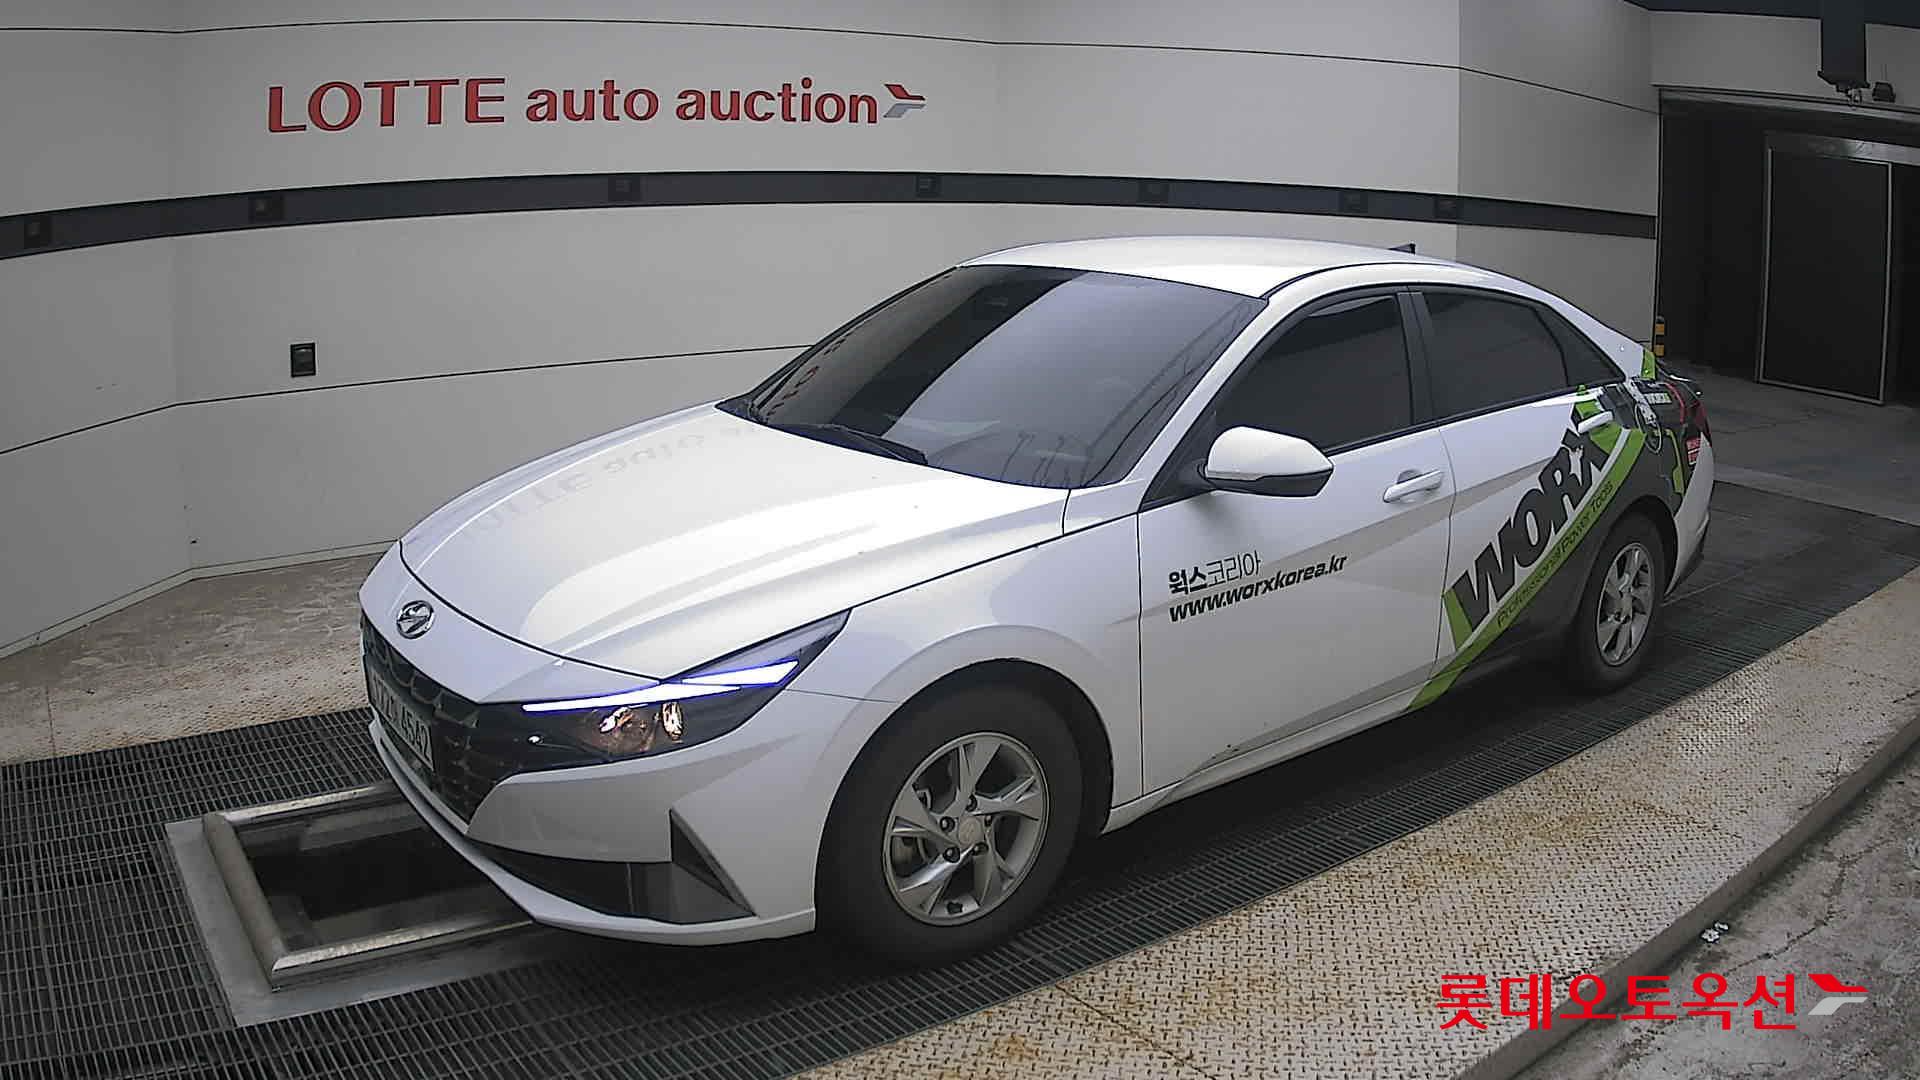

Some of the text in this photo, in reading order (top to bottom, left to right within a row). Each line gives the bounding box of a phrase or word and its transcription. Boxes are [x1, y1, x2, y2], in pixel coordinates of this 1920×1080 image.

[269, 77, 878, 133] LOTTE auto auction
[1451, 427, 1611, 633] WORX
[1168, 549, 1261, 595] 웍스코리아
[1169, 554, 1348, 622] www.worxkorea.kr
